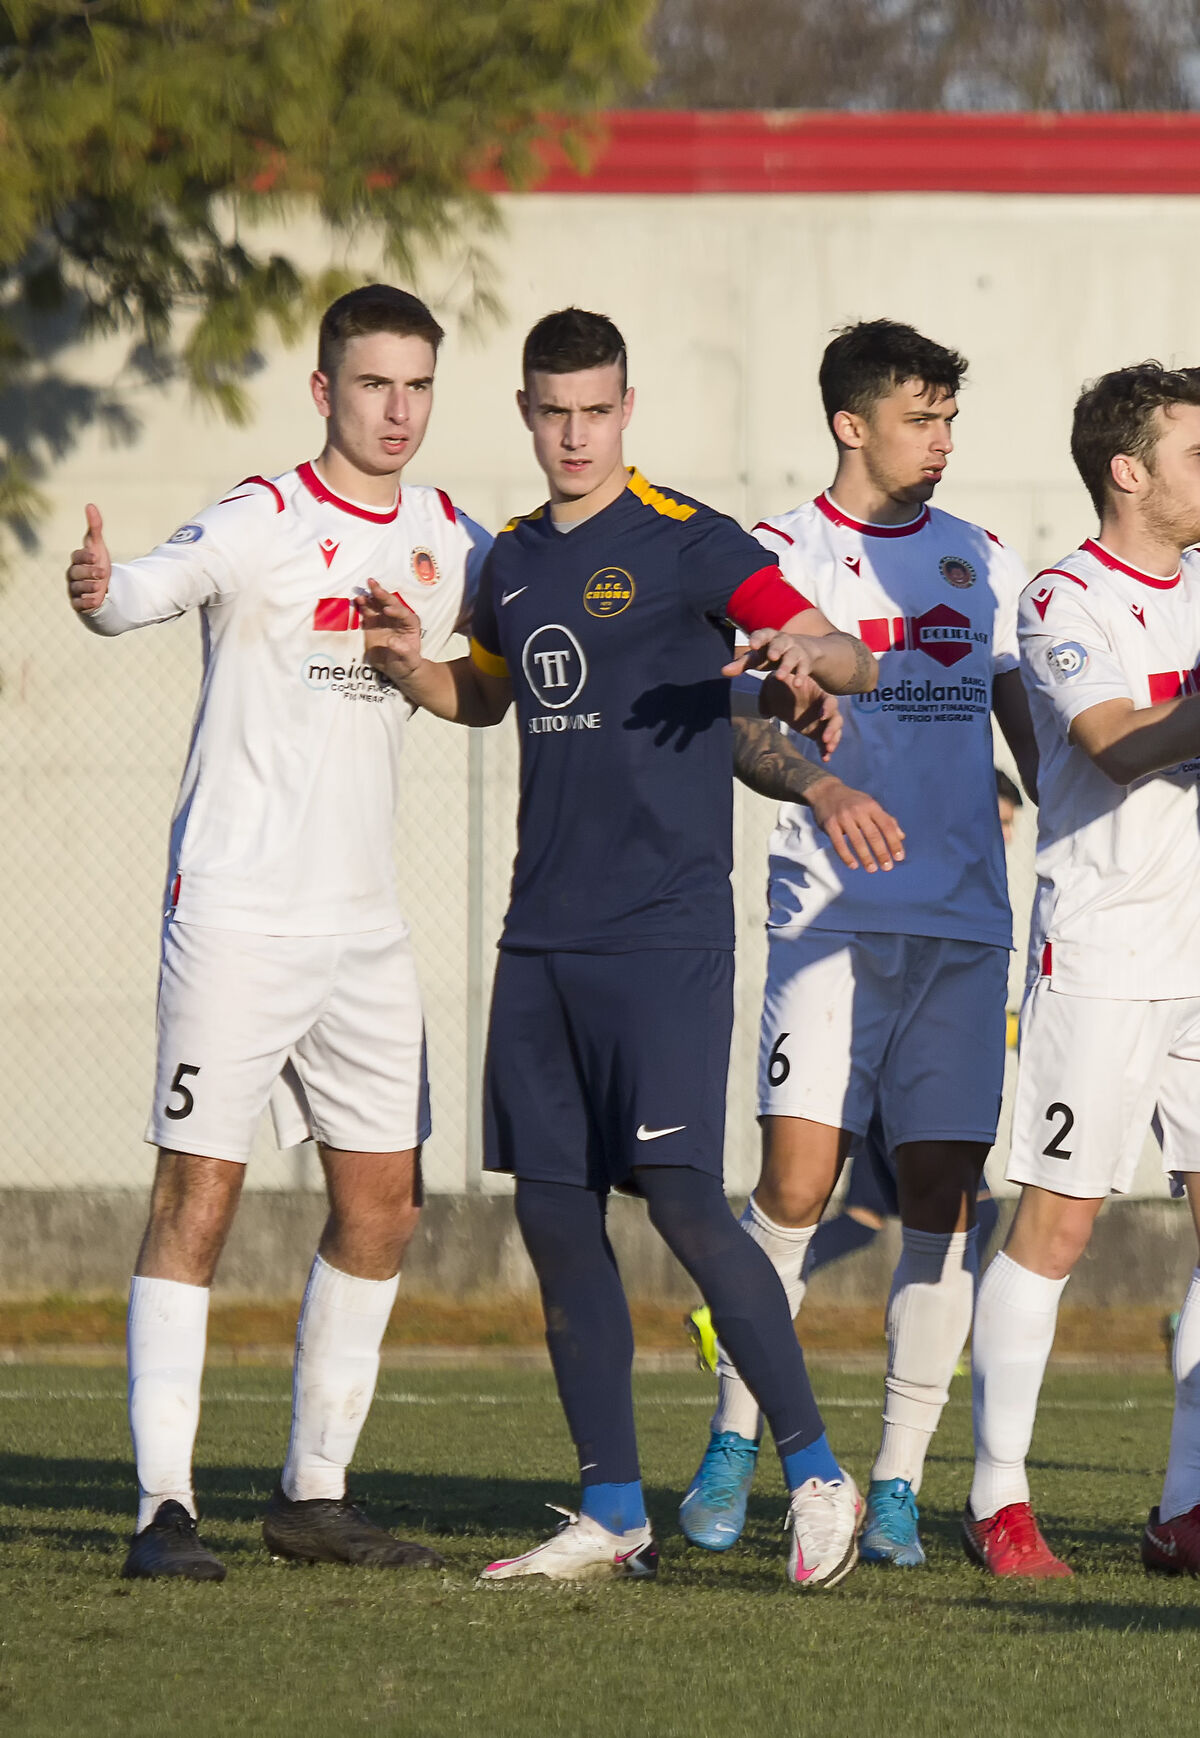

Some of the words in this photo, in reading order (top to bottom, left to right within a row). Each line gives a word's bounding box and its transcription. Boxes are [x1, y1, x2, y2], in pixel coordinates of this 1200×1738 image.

[585, 590, 630, 599] CHIONS
[859, 679, 987, 704] mediolanum
[767, 1032, 790, 1088] 6
[164, 1062, 201, 1120] 5
[1042, 1102, 1075, 1160] 2
